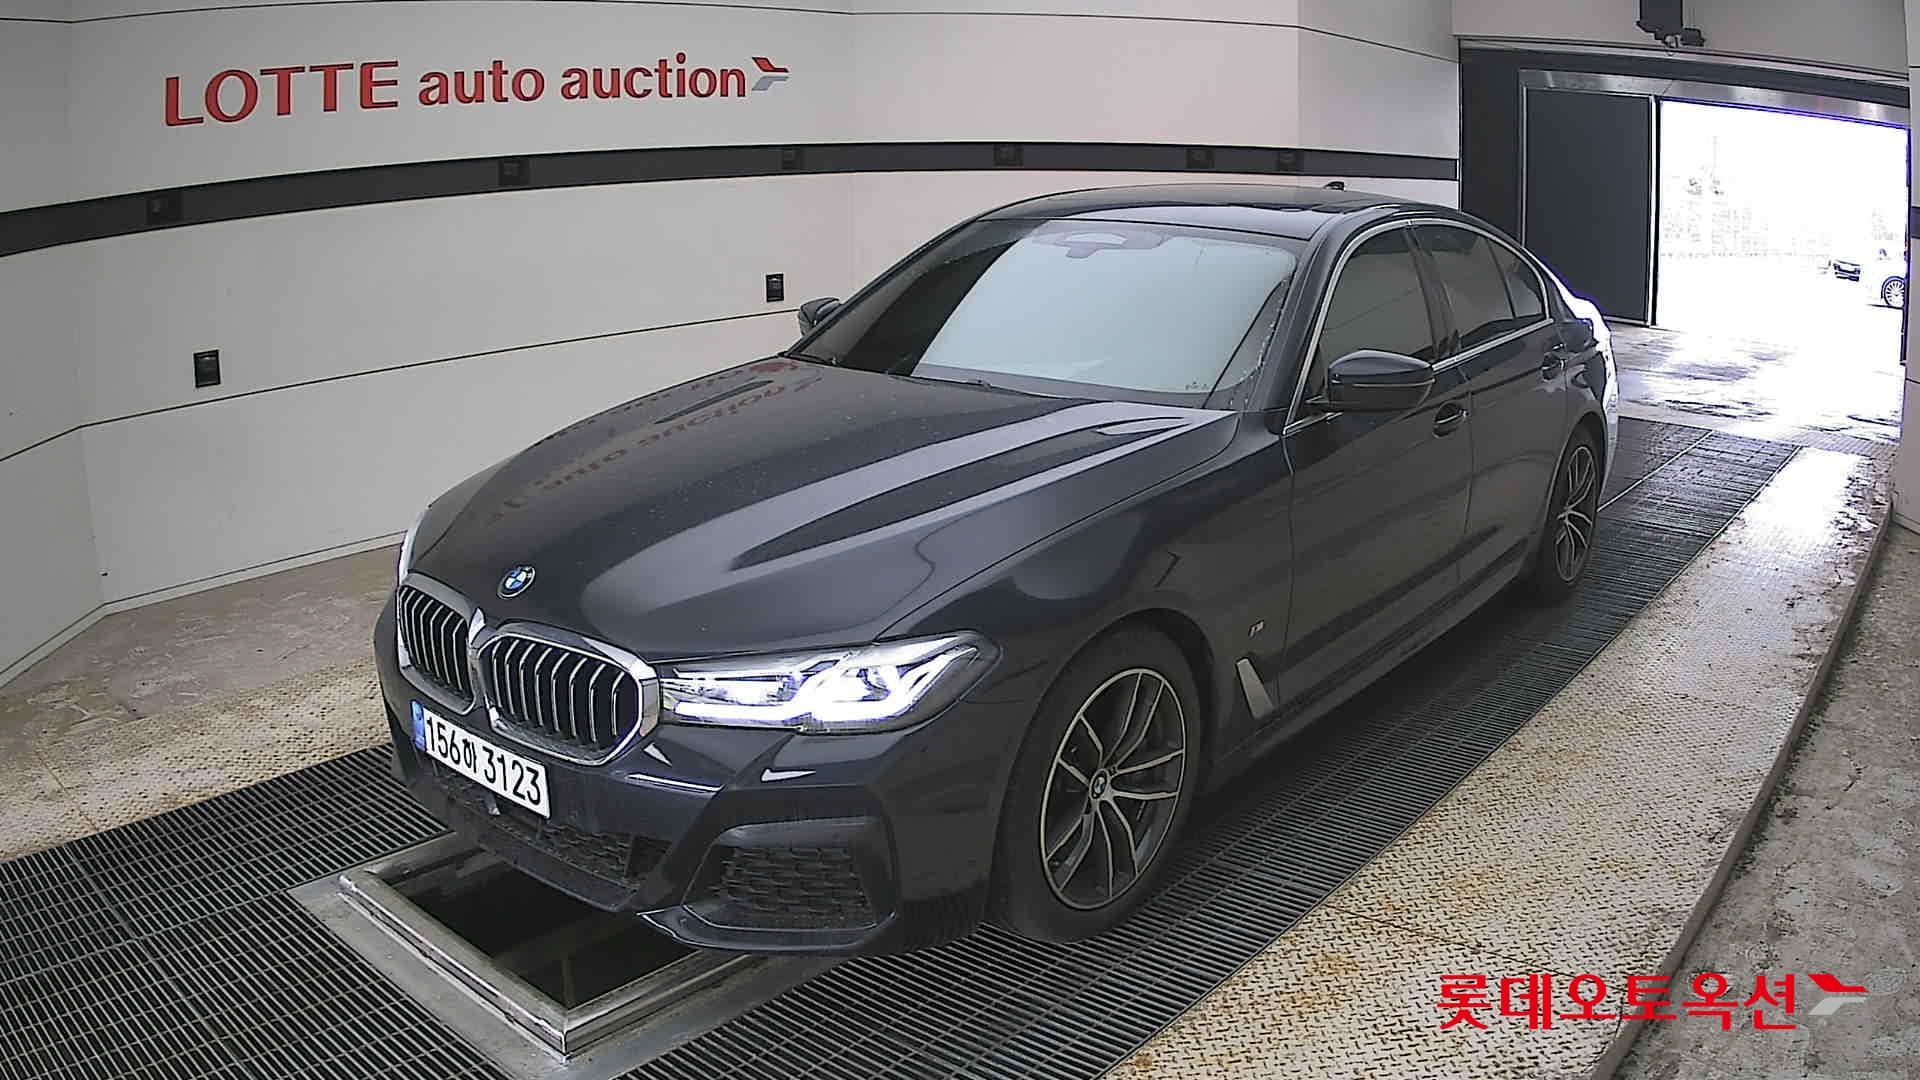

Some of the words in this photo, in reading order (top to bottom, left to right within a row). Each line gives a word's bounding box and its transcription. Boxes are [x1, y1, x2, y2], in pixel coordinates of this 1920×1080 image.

[164, 60, 400, 127] LOTTE
[418, 59, 546, 107] auto
[560, 52, 747, 100] auction
[482, 745, 542, 806] 3123
